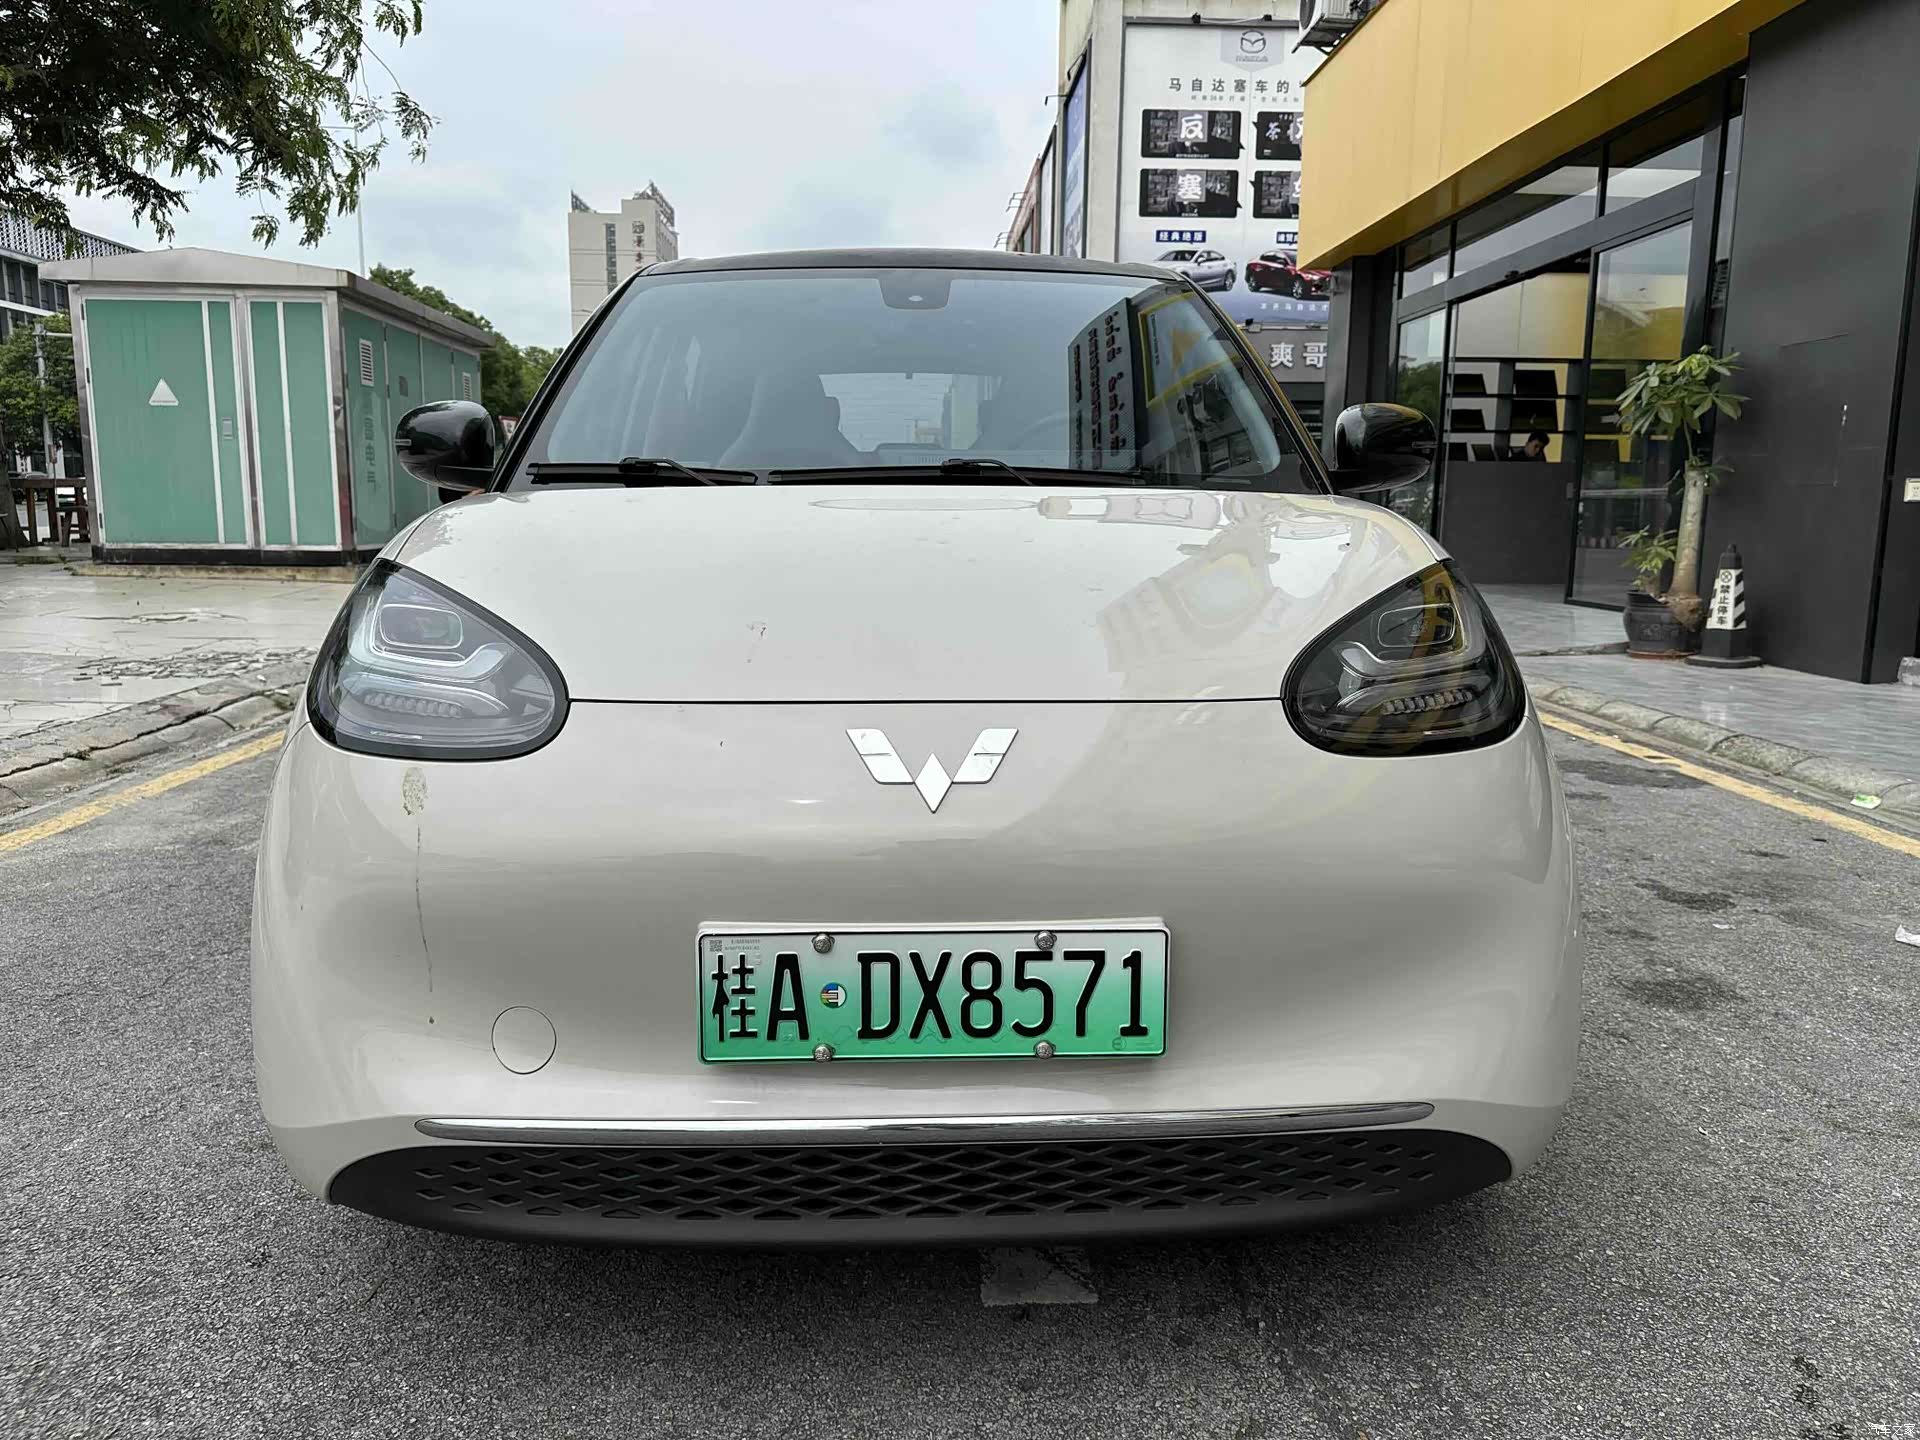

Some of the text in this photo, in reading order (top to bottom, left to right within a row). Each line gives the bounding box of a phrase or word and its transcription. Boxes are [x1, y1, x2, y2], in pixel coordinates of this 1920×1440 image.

[1270, 342, 1327, 369] 爽哥
[1716, 584, 1730, 625] 禁止停车
